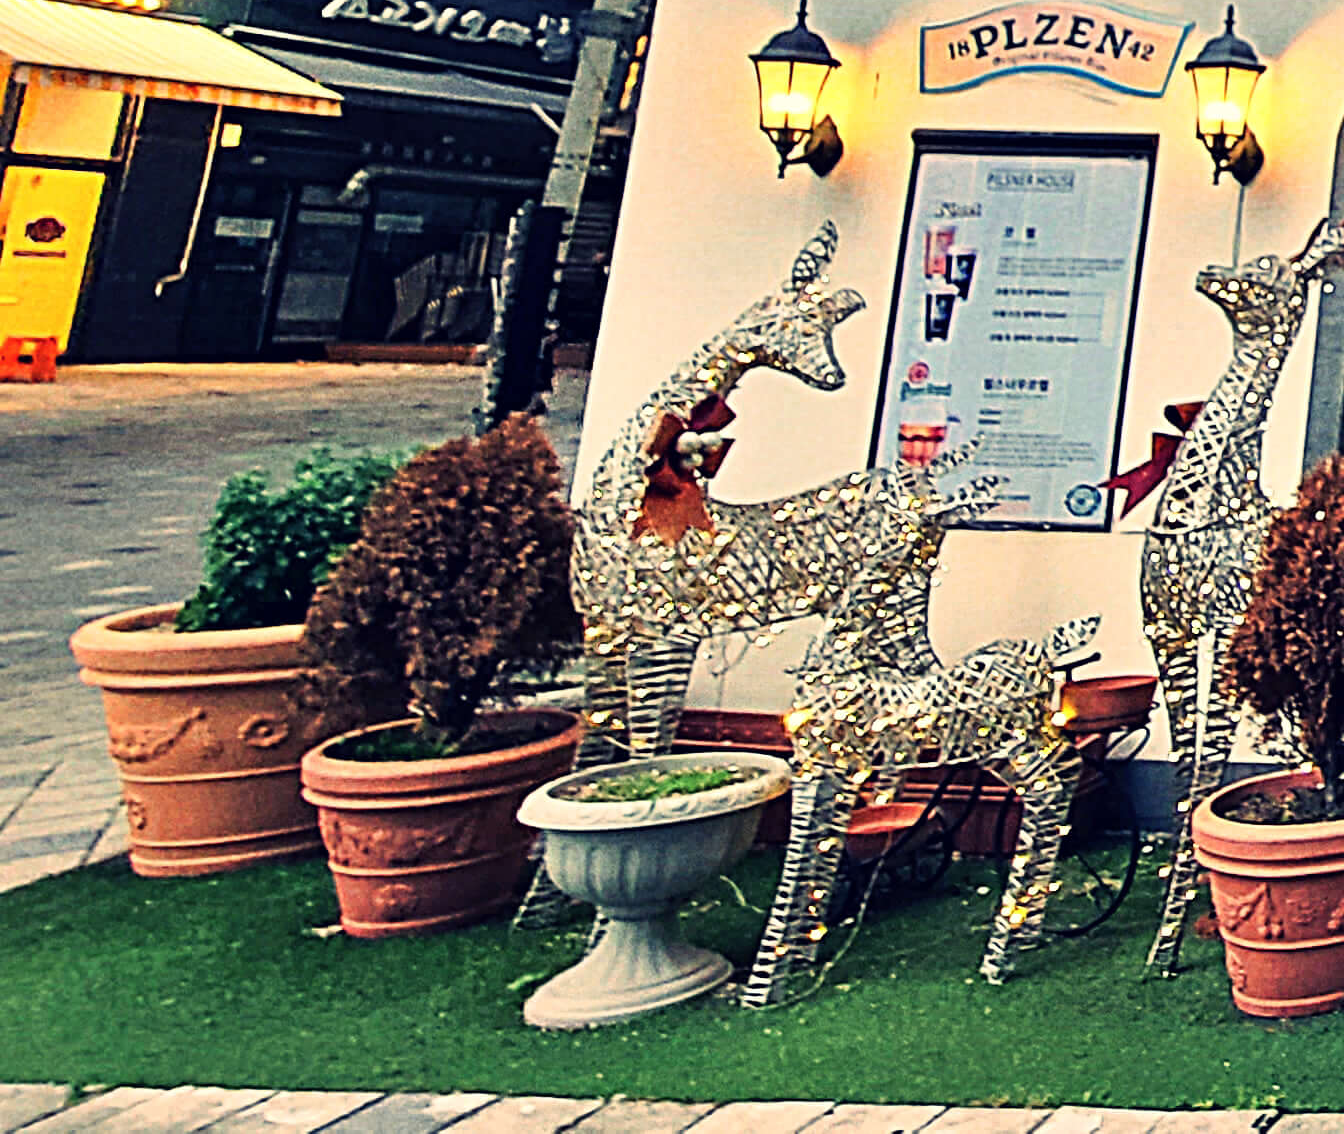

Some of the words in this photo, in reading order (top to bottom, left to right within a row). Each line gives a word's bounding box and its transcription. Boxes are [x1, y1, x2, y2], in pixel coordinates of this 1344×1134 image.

[948, 40, 970, 60] 18
[969, 13, 1133, 59] PLZEN
[1128, 41, 1155, 61] 42
